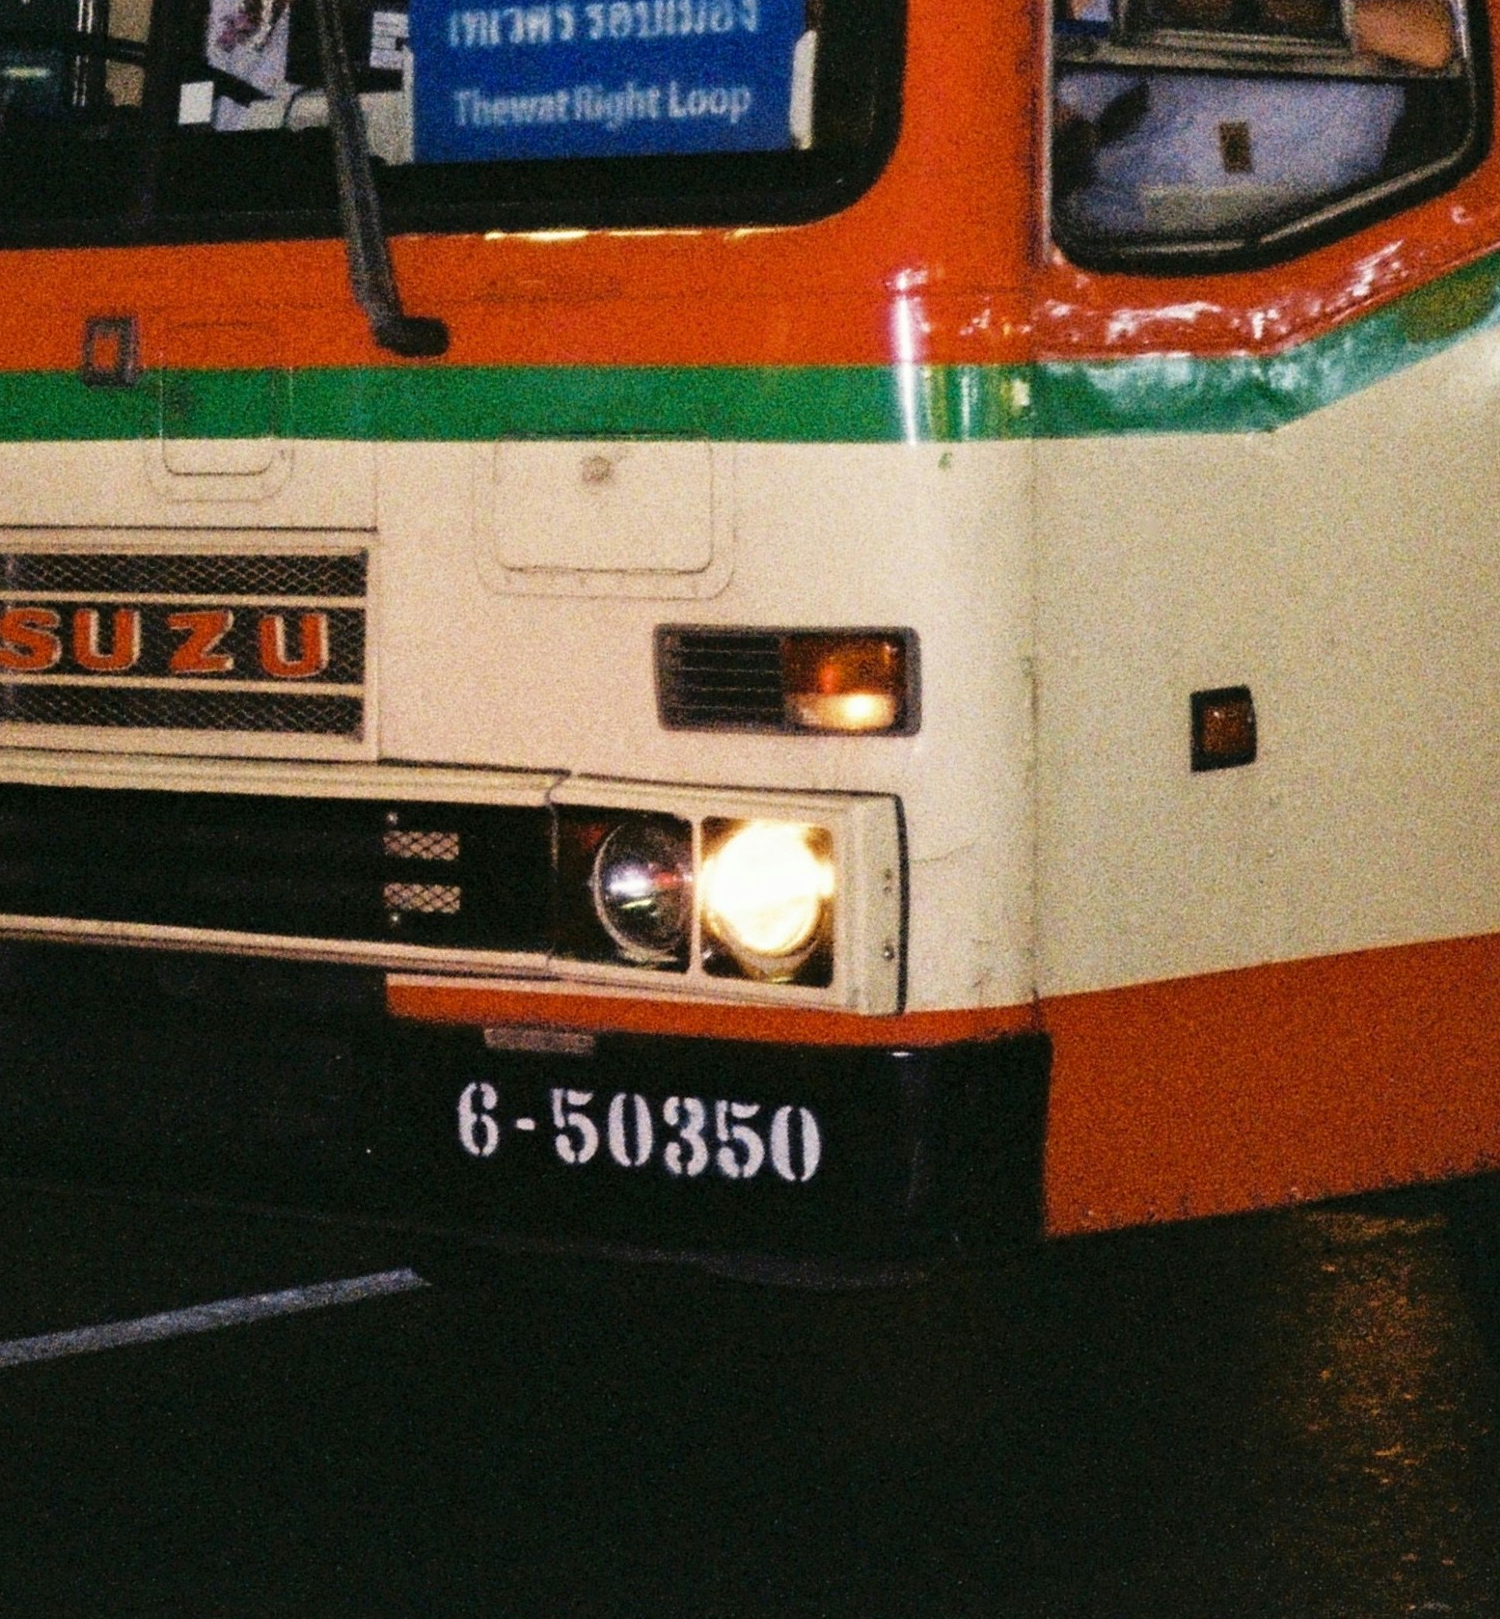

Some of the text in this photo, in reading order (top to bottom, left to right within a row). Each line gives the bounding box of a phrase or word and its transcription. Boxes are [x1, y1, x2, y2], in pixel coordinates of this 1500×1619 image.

[572, 80, 662, 133] Right
[666, 79, 753, 124] Loop
[456, 1080, 823, 1182] 6-50350
